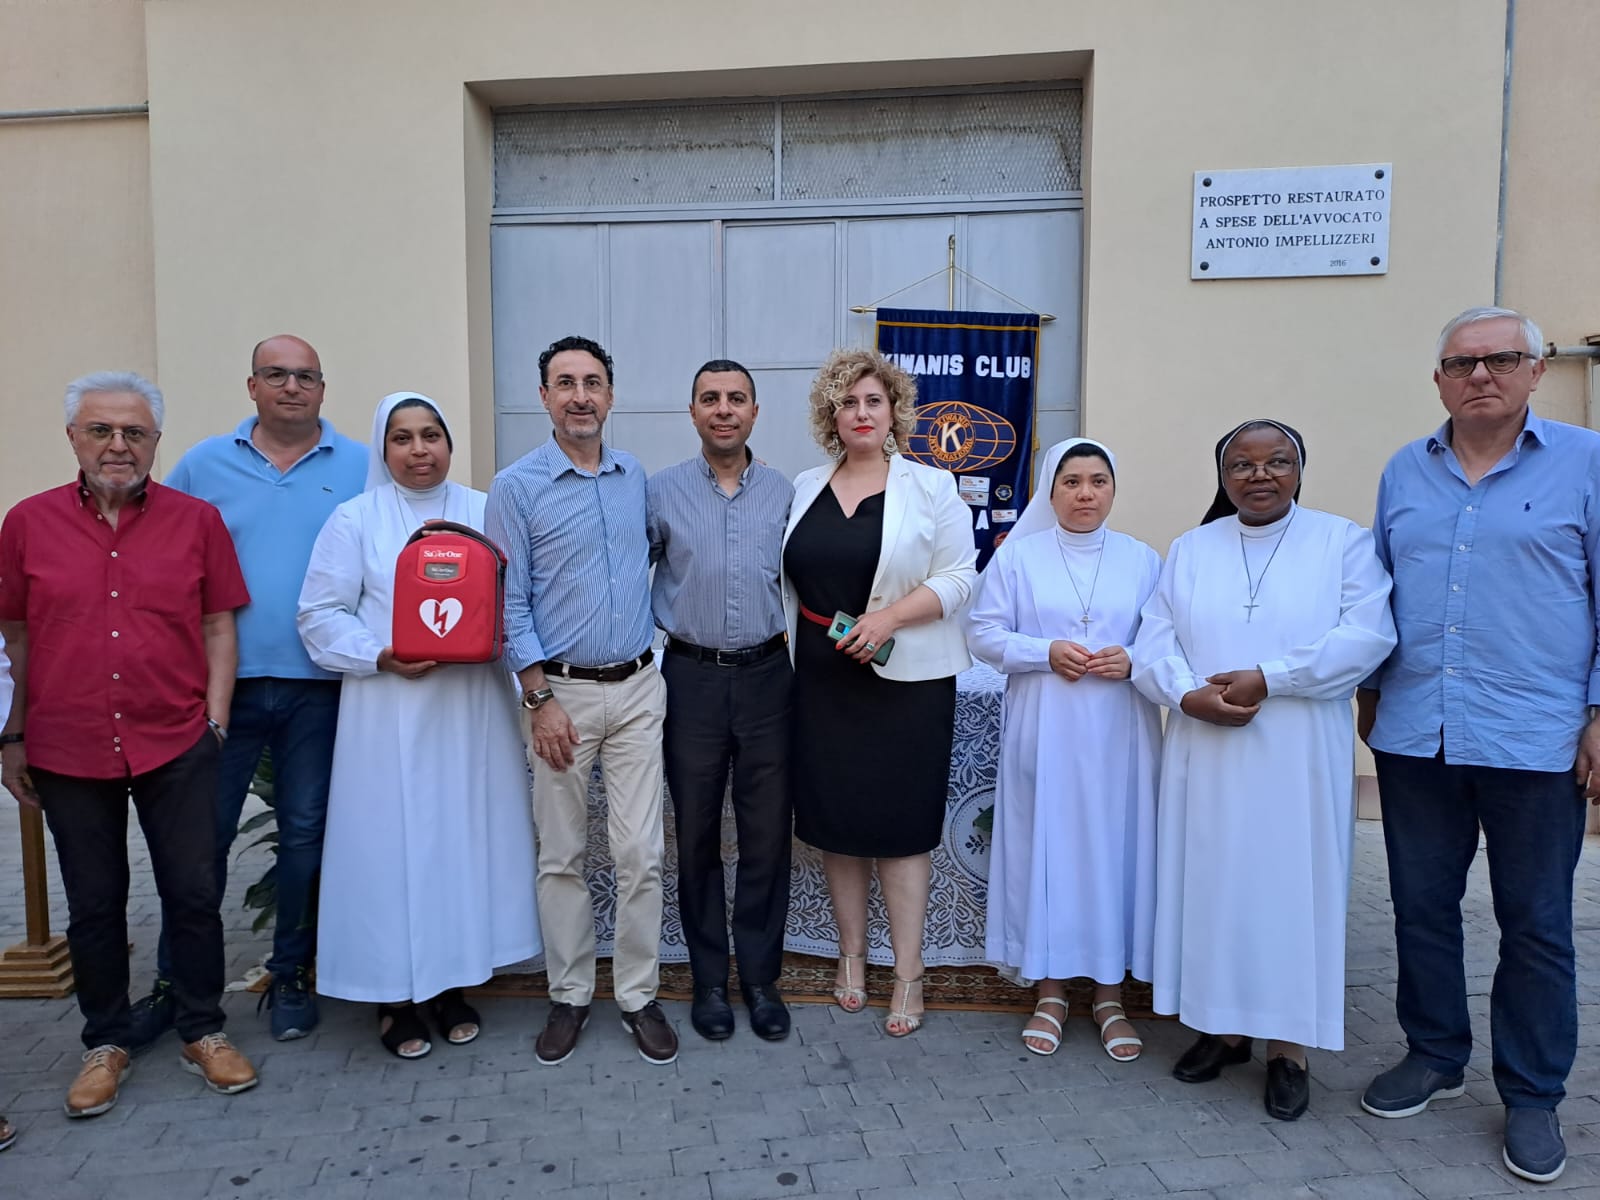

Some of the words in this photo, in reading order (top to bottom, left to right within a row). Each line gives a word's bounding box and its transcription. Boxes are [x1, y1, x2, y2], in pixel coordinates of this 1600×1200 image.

[1199, 193, 1281, 208] PROSPETTO
[1287, 189, 1385, 204] RESTAURATO
[1199, 217, 1209, 229] A
[1215, 216, 1257, 228] SPESE
[1263, 211, 1383, 227] DELL'AVVOCATO
[1205, 236, 1269, 249] ANTONIO
[1275, 232, 1375, 247] IMPELLIZZERI
[975, 355, 1031, 379] CLUB
[941, 422, 962, 452] K
